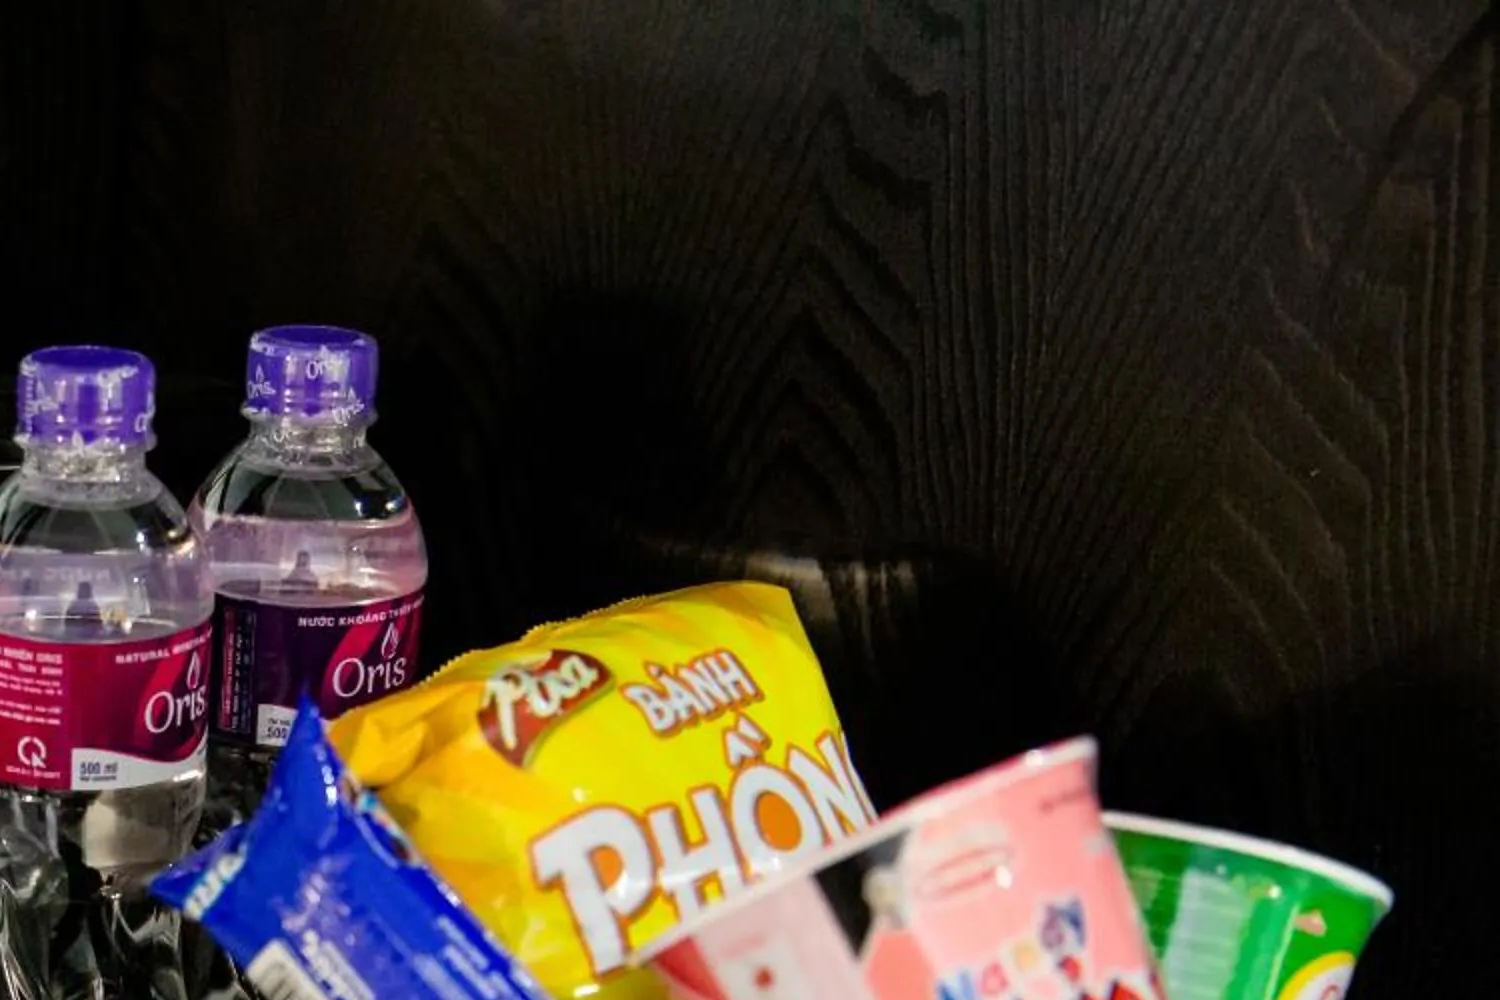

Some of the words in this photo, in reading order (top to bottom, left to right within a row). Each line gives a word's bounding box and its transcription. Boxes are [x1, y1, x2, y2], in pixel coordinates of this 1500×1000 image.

[332, 656, 407, 698] Oris
[621, 649, 764, 735] BÁNH
[143, 684, 208, 735] Oris
[79, 760, 101, 775] 500
[532, 714, 878, 978] PHỒN
